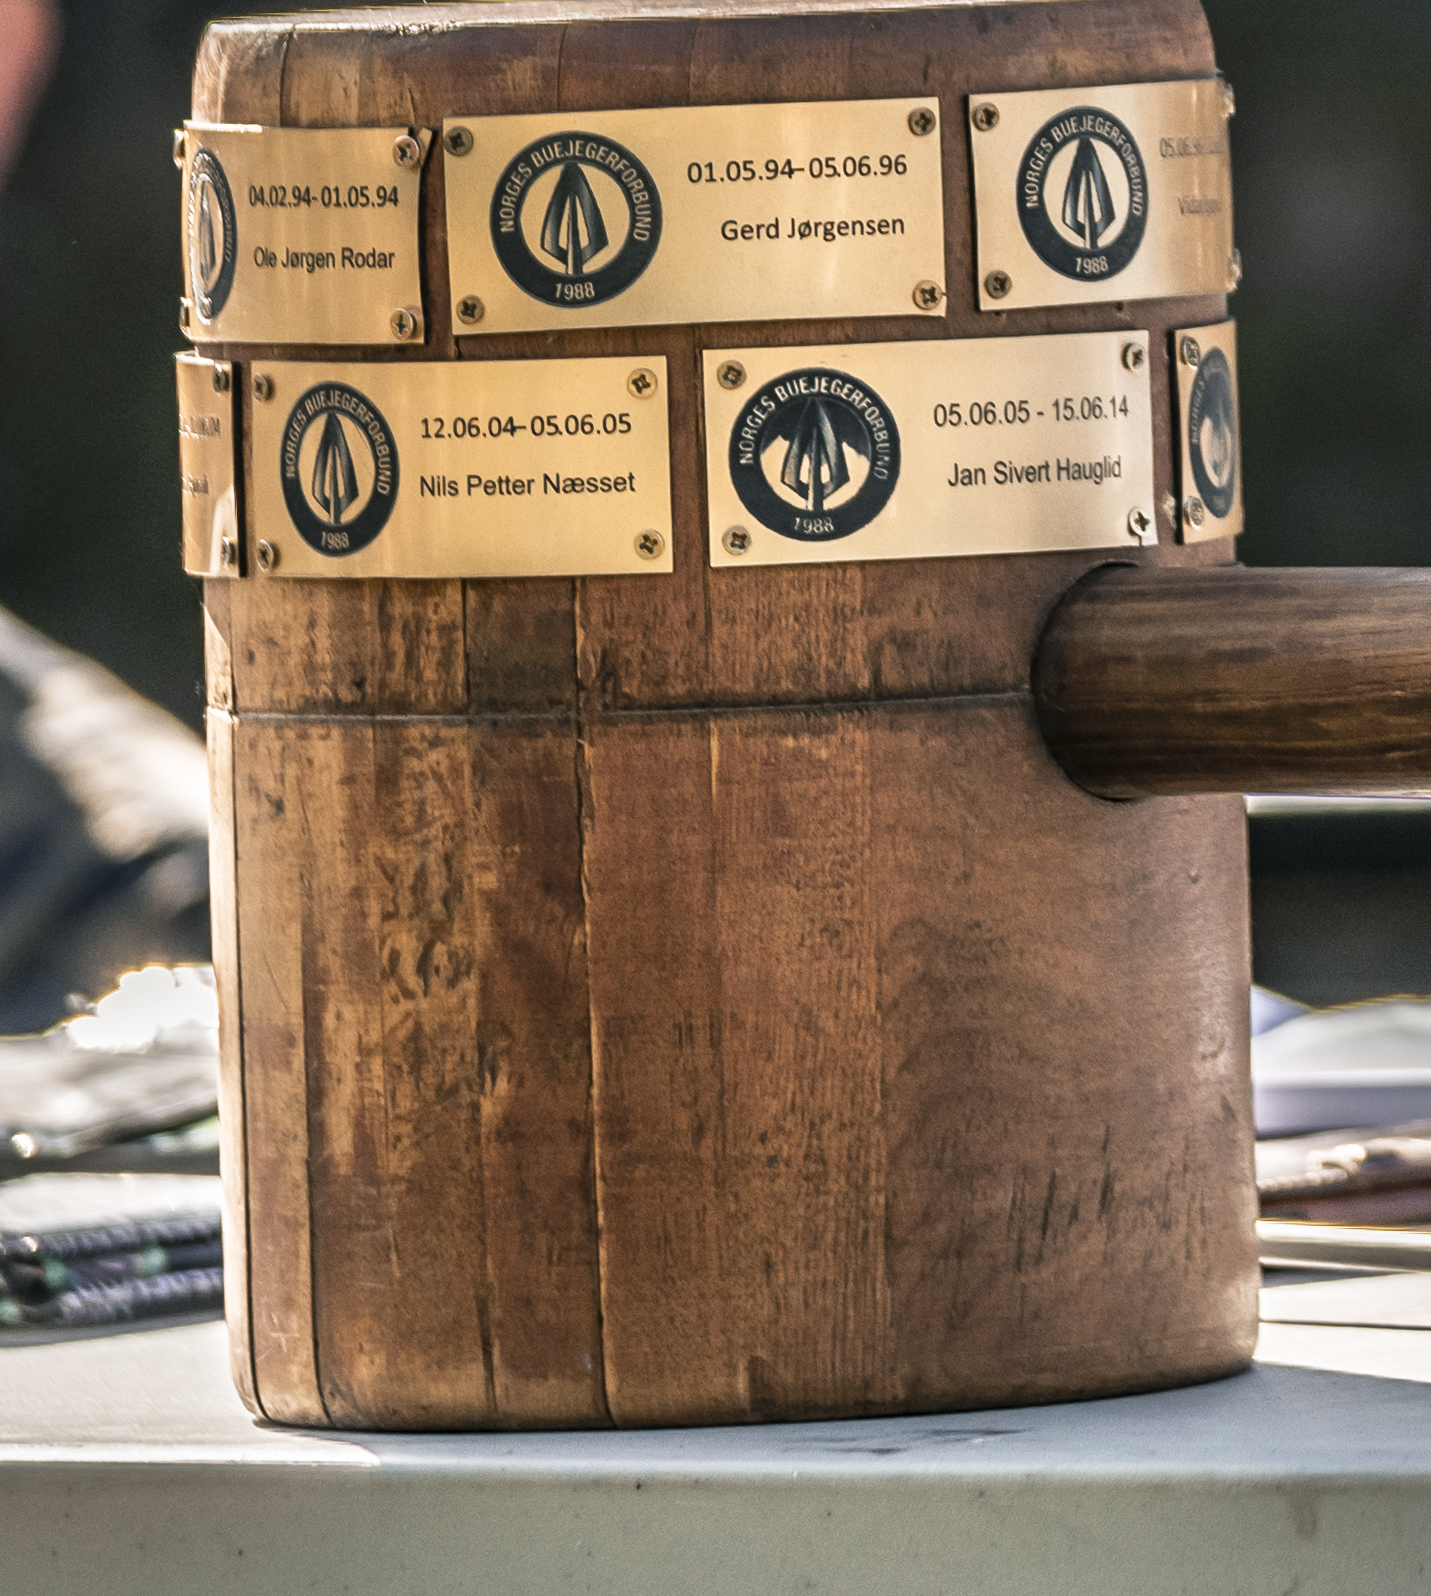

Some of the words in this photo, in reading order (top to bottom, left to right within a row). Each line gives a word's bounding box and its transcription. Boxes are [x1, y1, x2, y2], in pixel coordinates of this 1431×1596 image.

[1025, 137, 1054, 208] NORGES
[499, 162, 532, 233] NORGES
[530, 140, 652, 242] BUEJEGERFORBUND
[721, 217, 780, 241] Gerd
[787, 217, 905, 242] Jørgensen
[254, 246, 277, 269] Ole
[281, 246, 336, 273] Jørgen
[341, 246, 395, 269] Rodar
[1075, 256, 1109, 275] 1988
[555, 282, 595, 300] 1988
[933, 400, 1031, 427] 05.06.05
[1052, 395, 1129, 422] 15.06.14
[739, 395, 775, 465] NORGES
[285, 409, 307, 480] NORGES
[420, 475, 459, 497] Nils
[467, 474, 535, 496] Petter
[543, 472, 636, 495] Næsset
[947, 462, 987, 487] Jan
[993, 460, 1051, 485] Sivert
[1056, 455, 1122, 485] Hauglid
[794, 516, 834, 535] 1988
[321, 531, 350, 550] 1988
